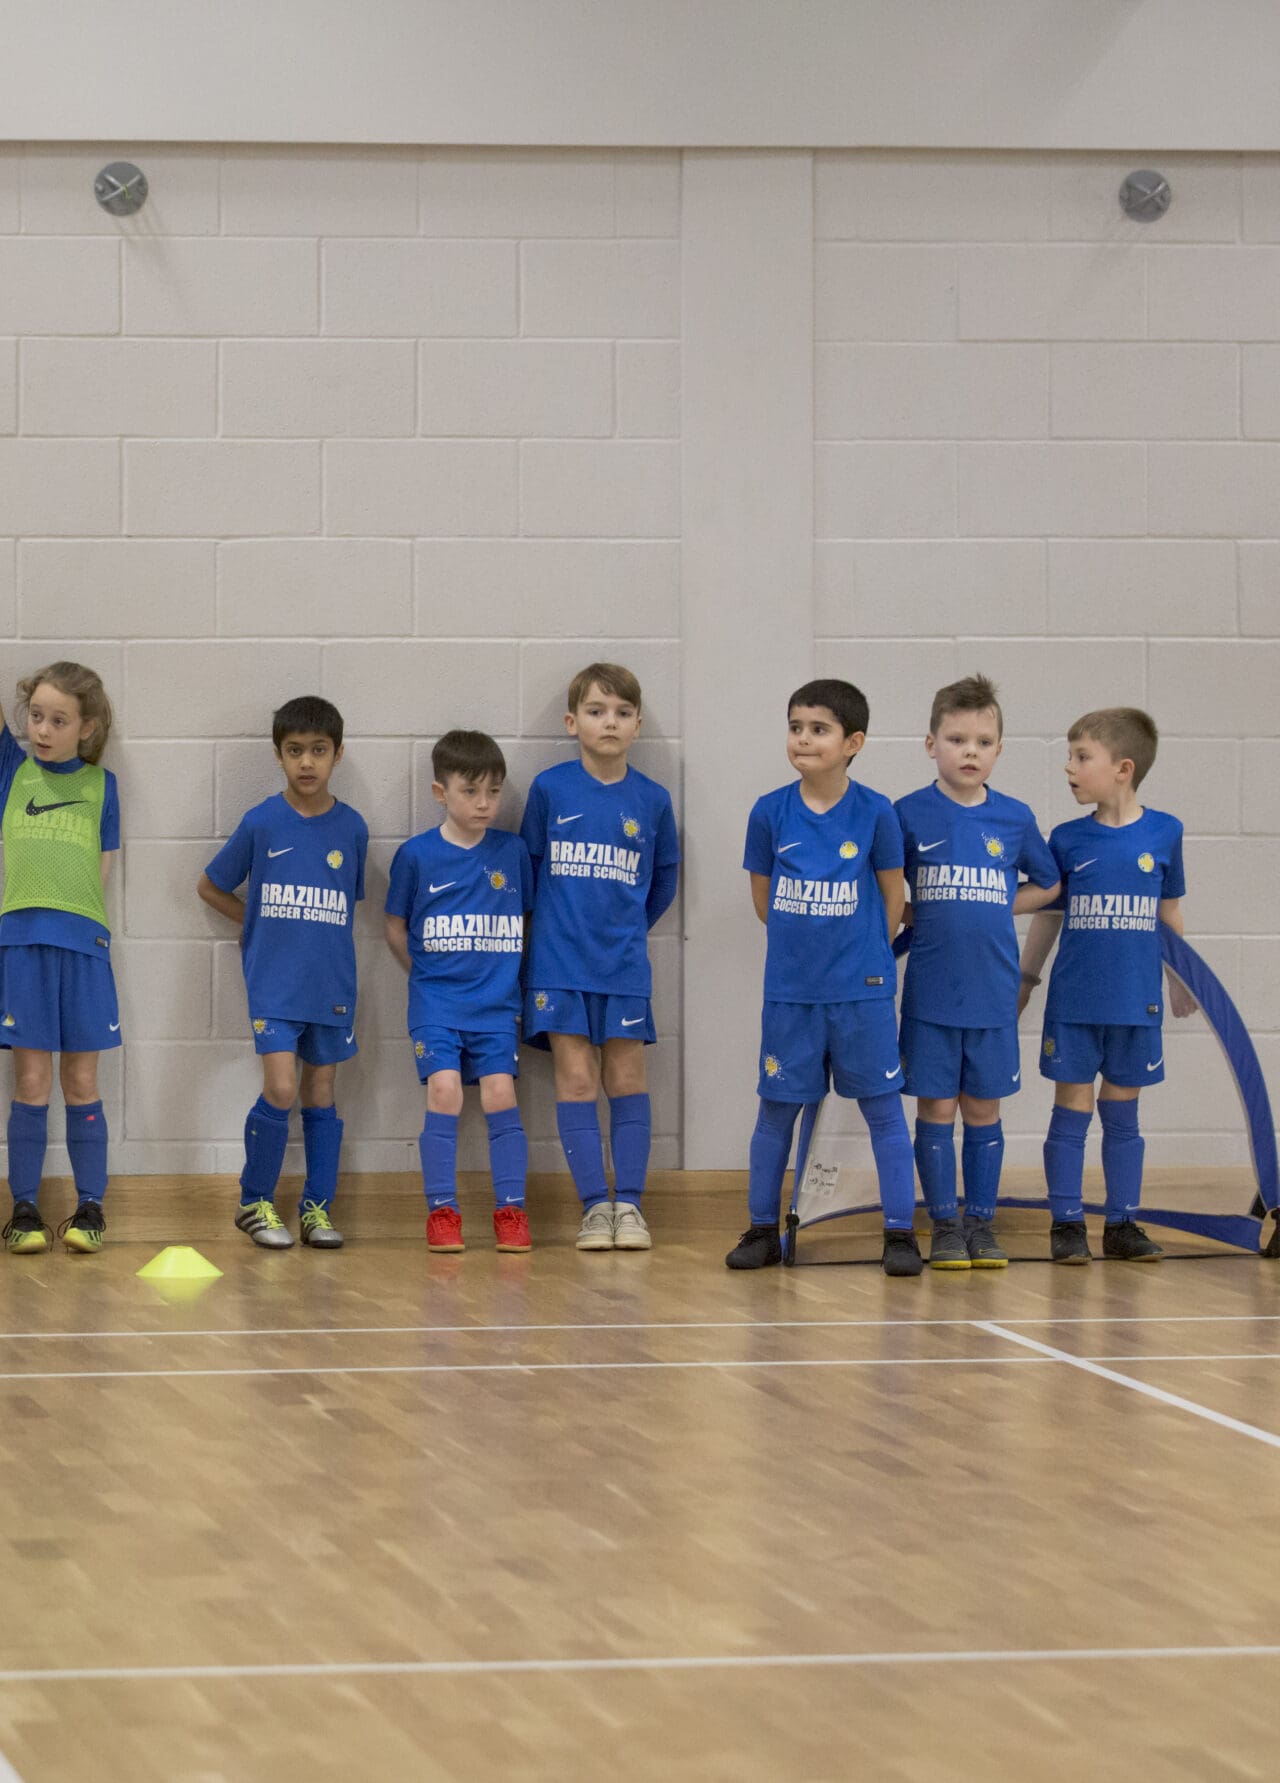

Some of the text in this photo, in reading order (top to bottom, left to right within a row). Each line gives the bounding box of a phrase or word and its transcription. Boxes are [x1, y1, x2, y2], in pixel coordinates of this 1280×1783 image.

[549, 841, 641, 872] BRAZILIAN
[550, 863, 591, 877] SOCCER
[916, 864, 1008, 891] BRAZILIAN
[261, 883, 348, 912] BRAZILIAN
[775, 875, 858, 903] BRAZILIAN
[916, 887, 1008, 905] SOCCER SCHOOLS
[260, 904, 348, 926] SOCCER SCHOOLS
[773, 897, 808, 915] SOCCER
[1069, 895, 1158, 917] BRAZILIAN
[423, 914, 523, 939] BRAZILIAN
[1068, 917, 1156, 932] SOCCER SCHOOLS
[423, 938, 523, 952] SOCCER SCHOOLS
